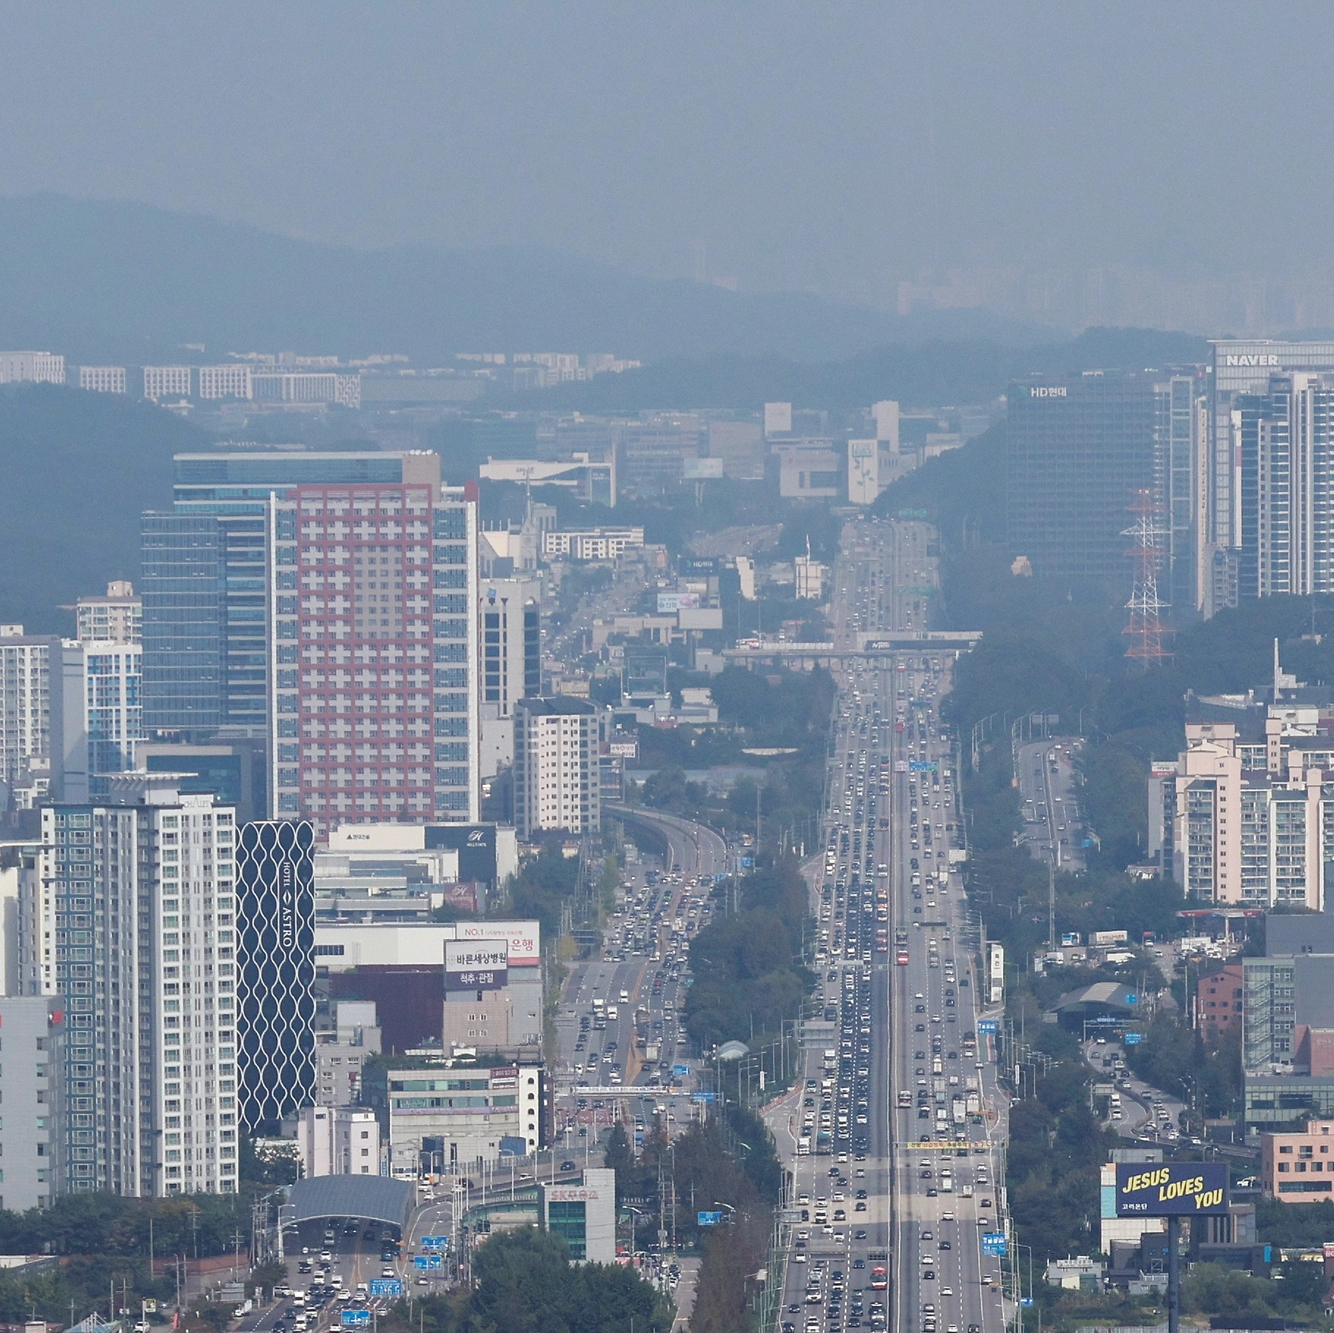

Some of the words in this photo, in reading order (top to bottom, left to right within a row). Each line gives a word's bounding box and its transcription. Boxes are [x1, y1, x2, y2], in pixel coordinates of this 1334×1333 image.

[1226, 355, 1278, 366] NAVER
[1031, 387, 1066, 397] HD현대
[283, 861, 292, 887] HOTEL
[282, 907, 293, 948] ASTRO
[456, 953, 507, 965] 바른세상병원
[1122, 1168, 1169, 1193] JESUS
[1159, 1176, 1203, 1202] LOVES
[552, 1190, 599, 1201] SK주유소
[1194, 1188, 1223, 1210] YOU
